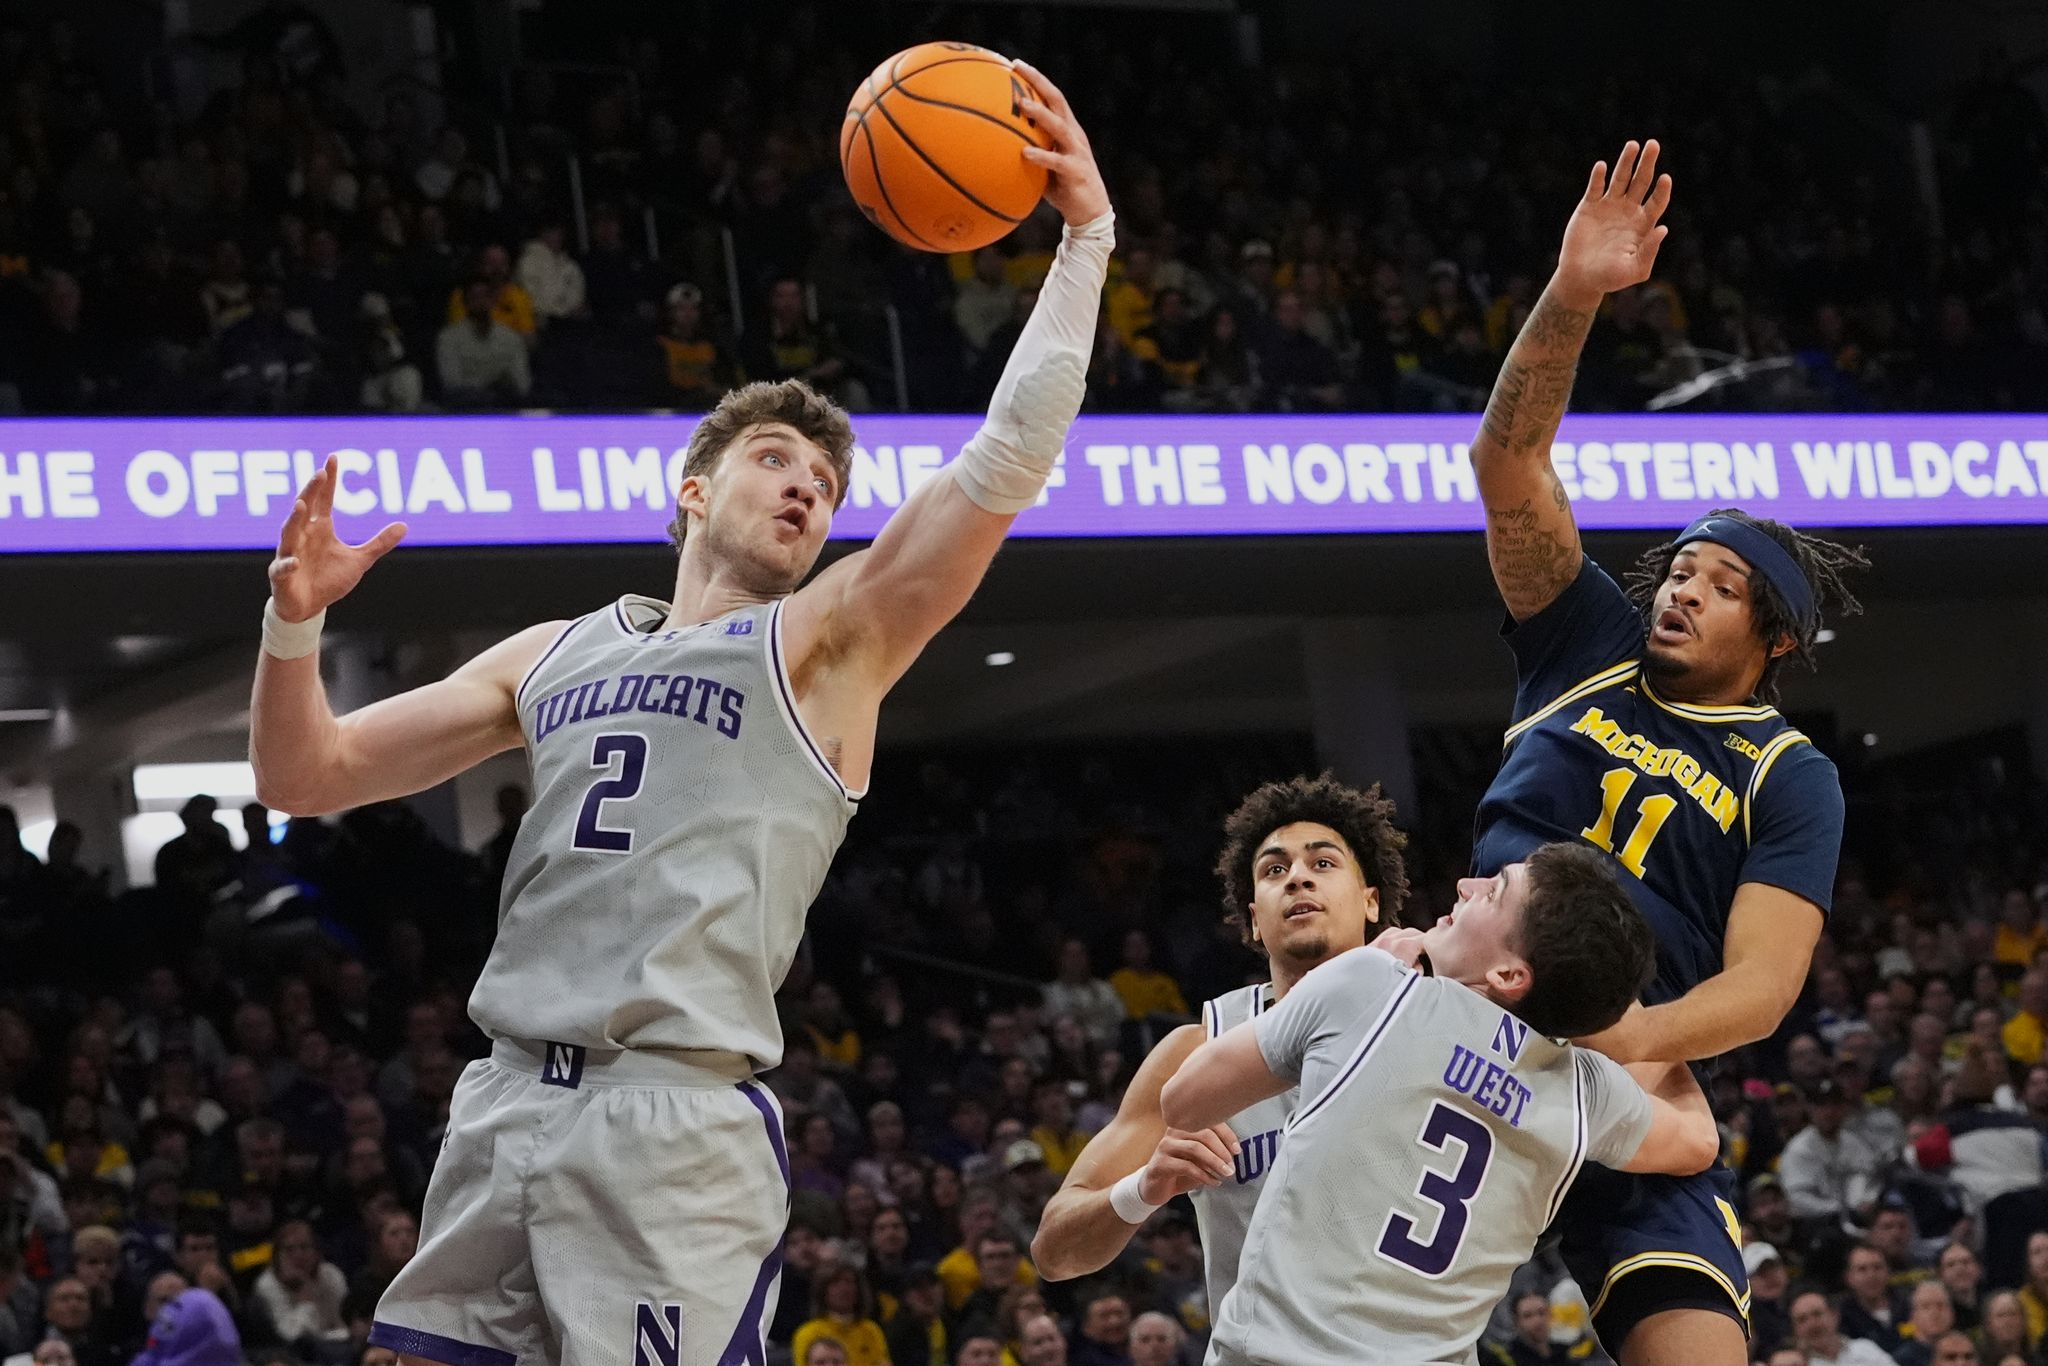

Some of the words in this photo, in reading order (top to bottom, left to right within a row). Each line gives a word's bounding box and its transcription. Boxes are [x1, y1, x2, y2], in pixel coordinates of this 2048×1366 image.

[125, 447, 512, 517] OFFICIAL
[1085, 444, 1227, 508] THE
[1242, 442, 1781, 504] NORTHESTERN
[534, 673, 745, 744] WILDCATS
[570, 731, 650, 855] 2
[1569, 706, 1739, 835] MICHIGAN
[1580, 766, 1678, 880] 11
[551, 1046, 574, 1080] N
[1490, 1011, 1528, 1064] N
[1443, 1044, 1533, 1128] WEST
[1374, 1097, 1496, 1281] 3
[634, 1302, 683, 1366] N
